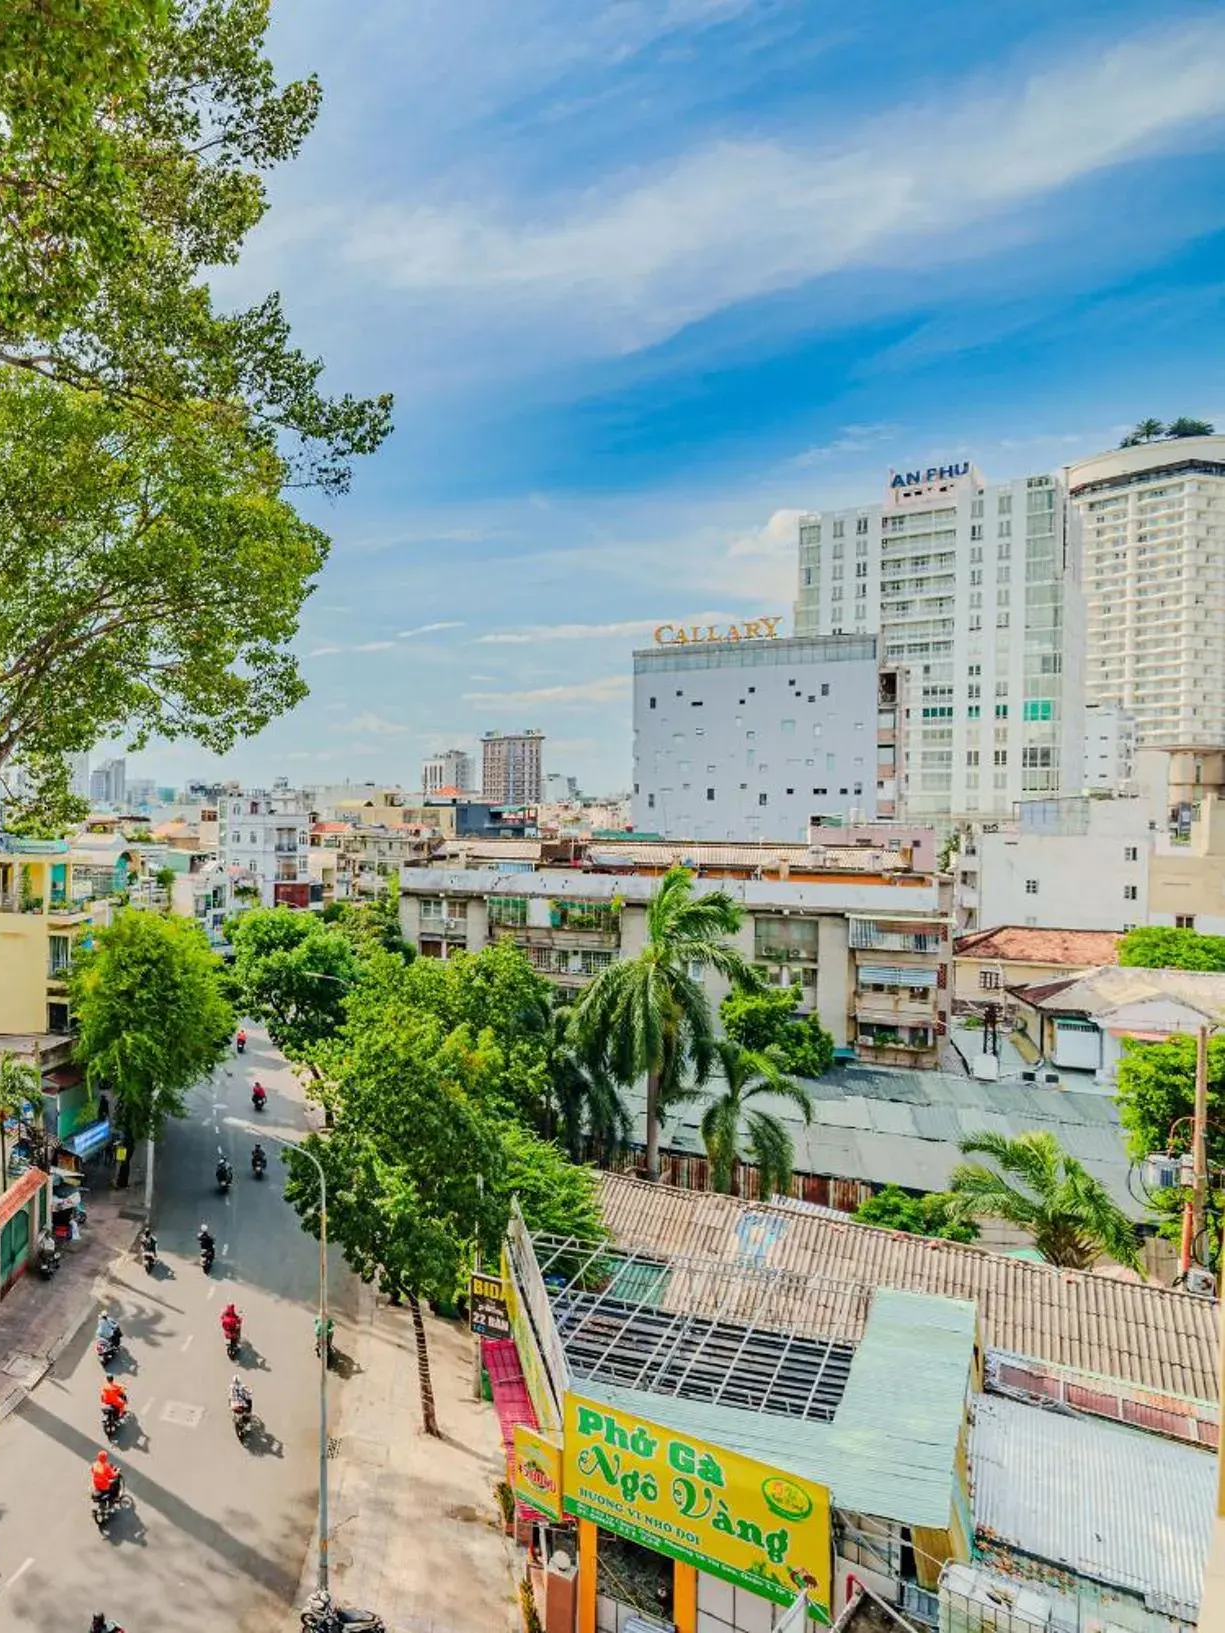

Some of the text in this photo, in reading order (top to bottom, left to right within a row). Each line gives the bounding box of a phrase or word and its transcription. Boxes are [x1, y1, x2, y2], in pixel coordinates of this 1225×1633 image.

[891, 470, 921, 488] AN
[654, 616, 783, 643] CALLARY
[472, 1311, 486, 1325] 22
[577, 1406, 725, 1488] Phở Gà
[577, 1445, 659, 1502] Ngô
[672, 1477, 789, 1565] Vàng
